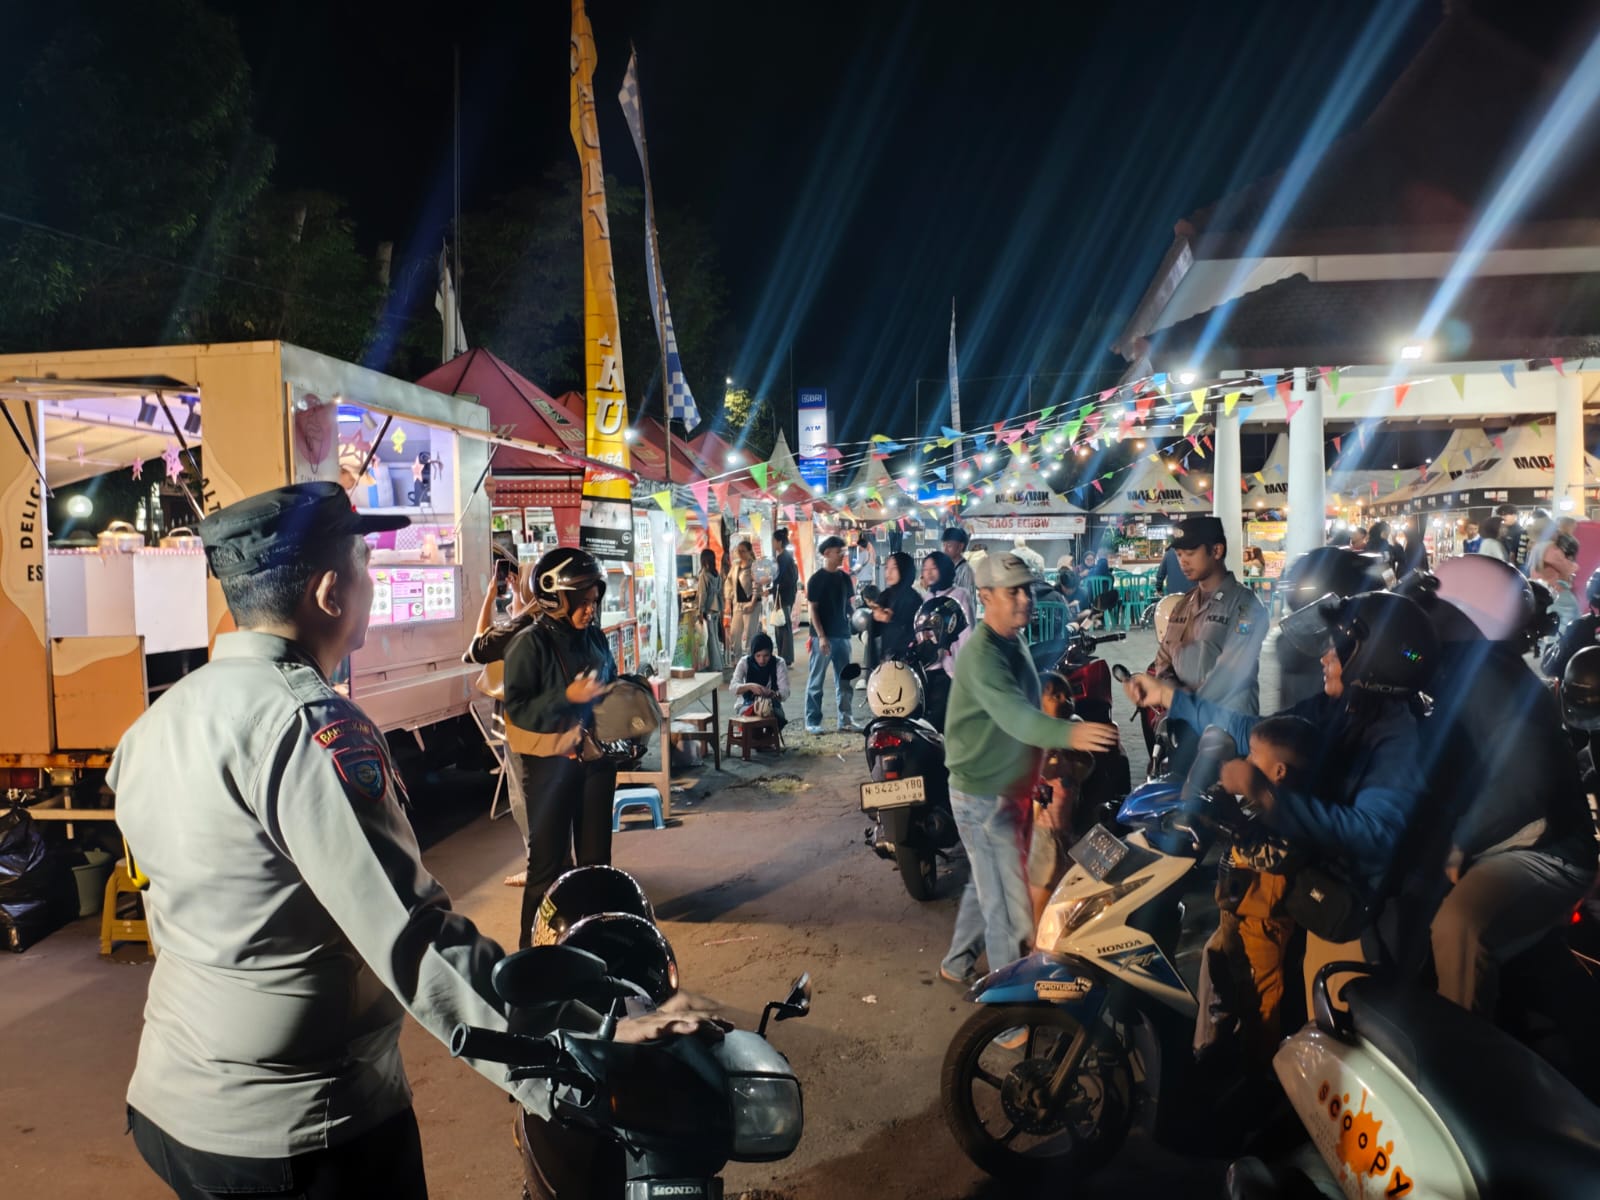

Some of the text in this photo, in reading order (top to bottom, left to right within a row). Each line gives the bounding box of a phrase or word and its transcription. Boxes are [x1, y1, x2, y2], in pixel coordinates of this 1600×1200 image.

[546, 535, 557, 544] ES
[1096, 938, 1143, 955] HONDA
[652, 1185, 702, 1197] HONDA
